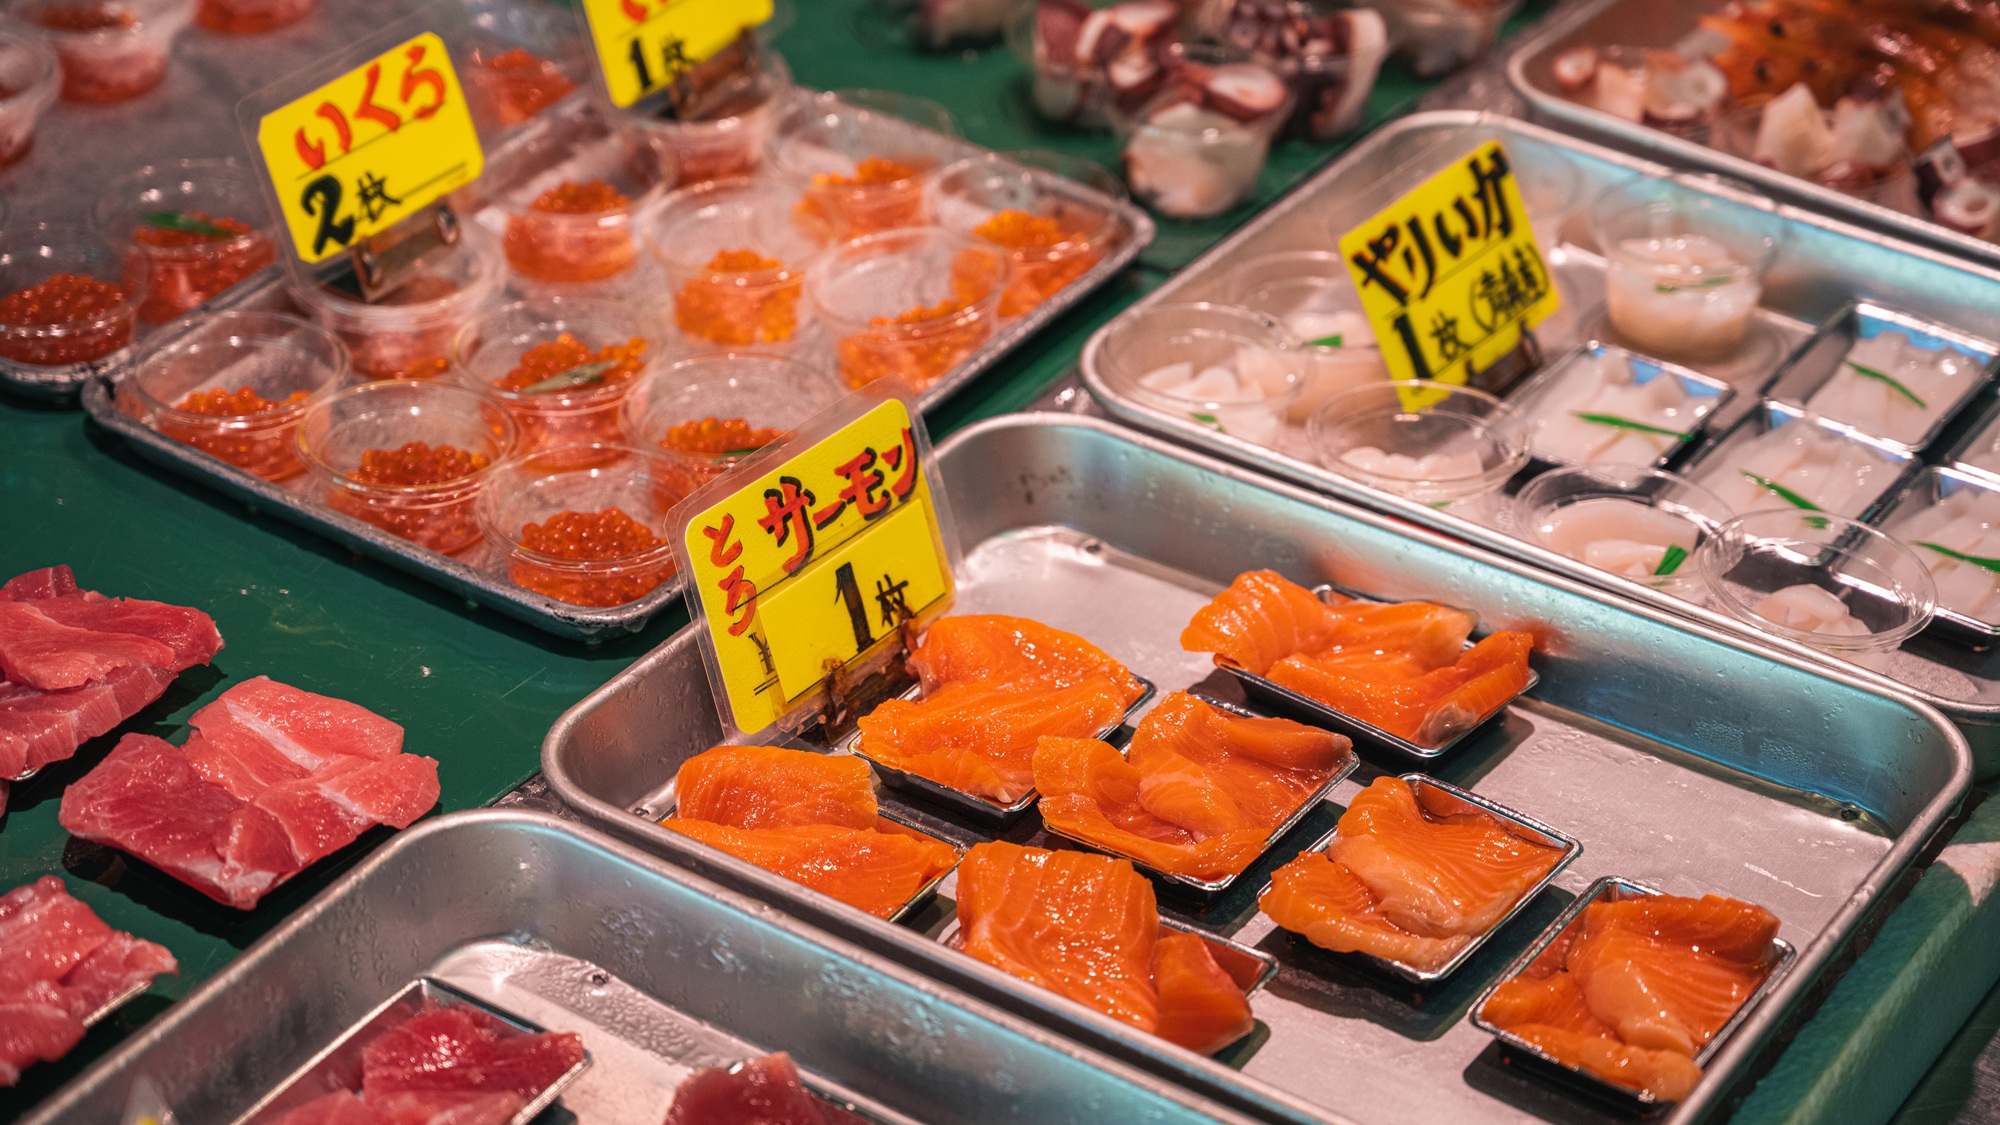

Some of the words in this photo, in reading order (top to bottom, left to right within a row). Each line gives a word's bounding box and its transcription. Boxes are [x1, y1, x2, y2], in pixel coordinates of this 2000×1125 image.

[296, 46, 446, 170] いくら
[301, 172, 402, 255] 2枚
[757, 427, 920, 576] サーモン
[702, 513, 758, 636] とろ
[835, 562, 917, 654] 1枚
